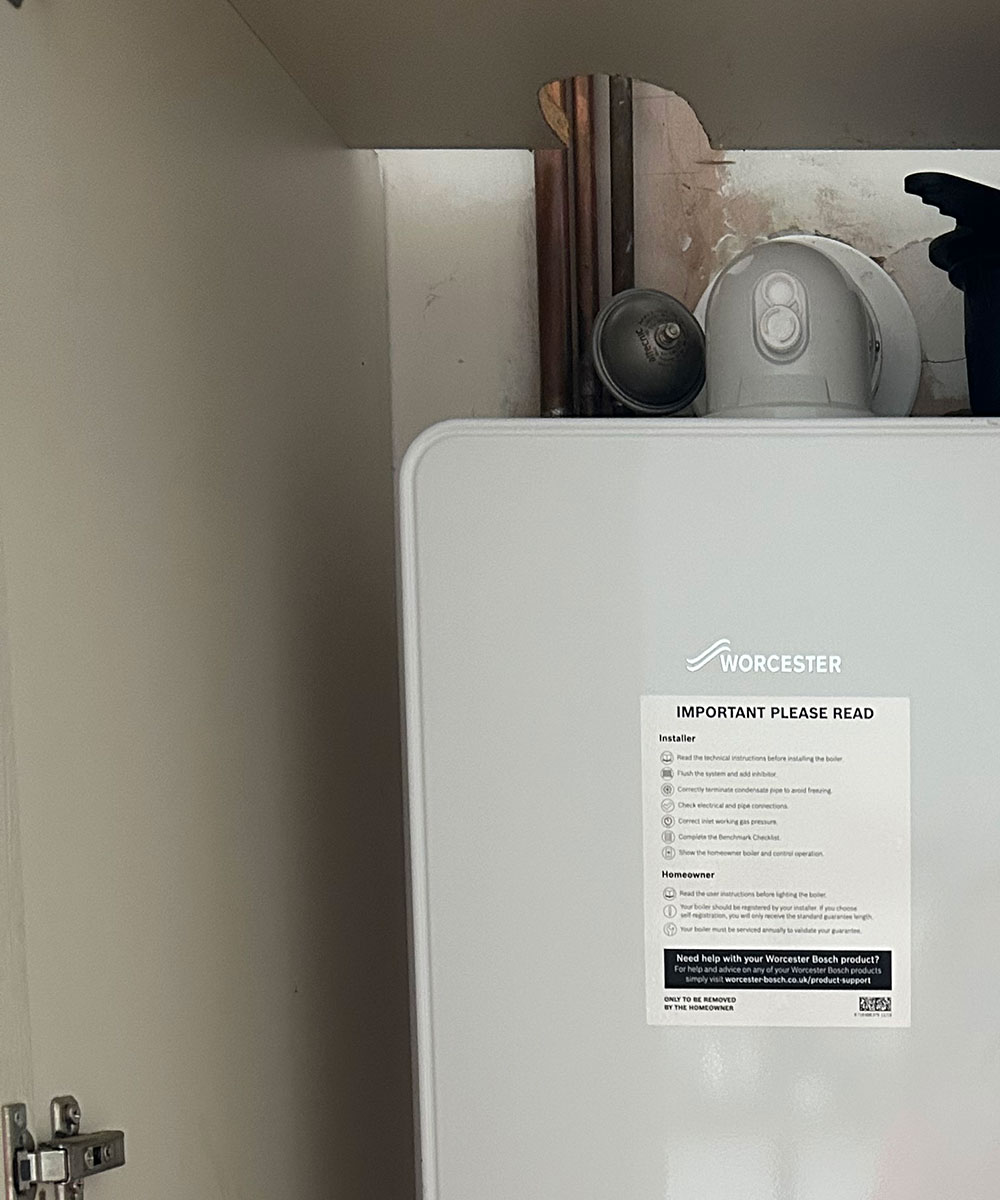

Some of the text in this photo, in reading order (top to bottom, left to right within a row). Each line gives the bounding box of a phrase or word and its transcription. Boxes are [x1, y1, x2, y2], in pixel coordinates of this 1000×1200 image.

[720, 654, 842, 674] WORCESTER
[676, 705, 875, 720] IMPORTANT PLEASE READ
[659, 734, 696, 742] Installer
[704, 754, 730, 762] technical
[732, 754, 766, 762] instructions
[705, 770, 726, 778] system
[677, 786, 704, 794] Correctly
[734, 786, 769, 794] condensate
[662, 870, 715, 879] Homeowner
[742, 904, 771, 912] registered
[676, 954, 880, 965] Need help with your Worcester Bosch product?
[674, 965, 686, 973] For
[687, 966, 703, 974] help
[718, 966, 741, 974] advice
[766, 966, 774, 974] of
[790, 966, 827, 974] Worcester
[827, 966, 850, 974] Bosch
[850, 967, 882, 975] products
[685, 976, 708, 984] simply
[688, 1004, 734, 1012] HOMEOWNER
